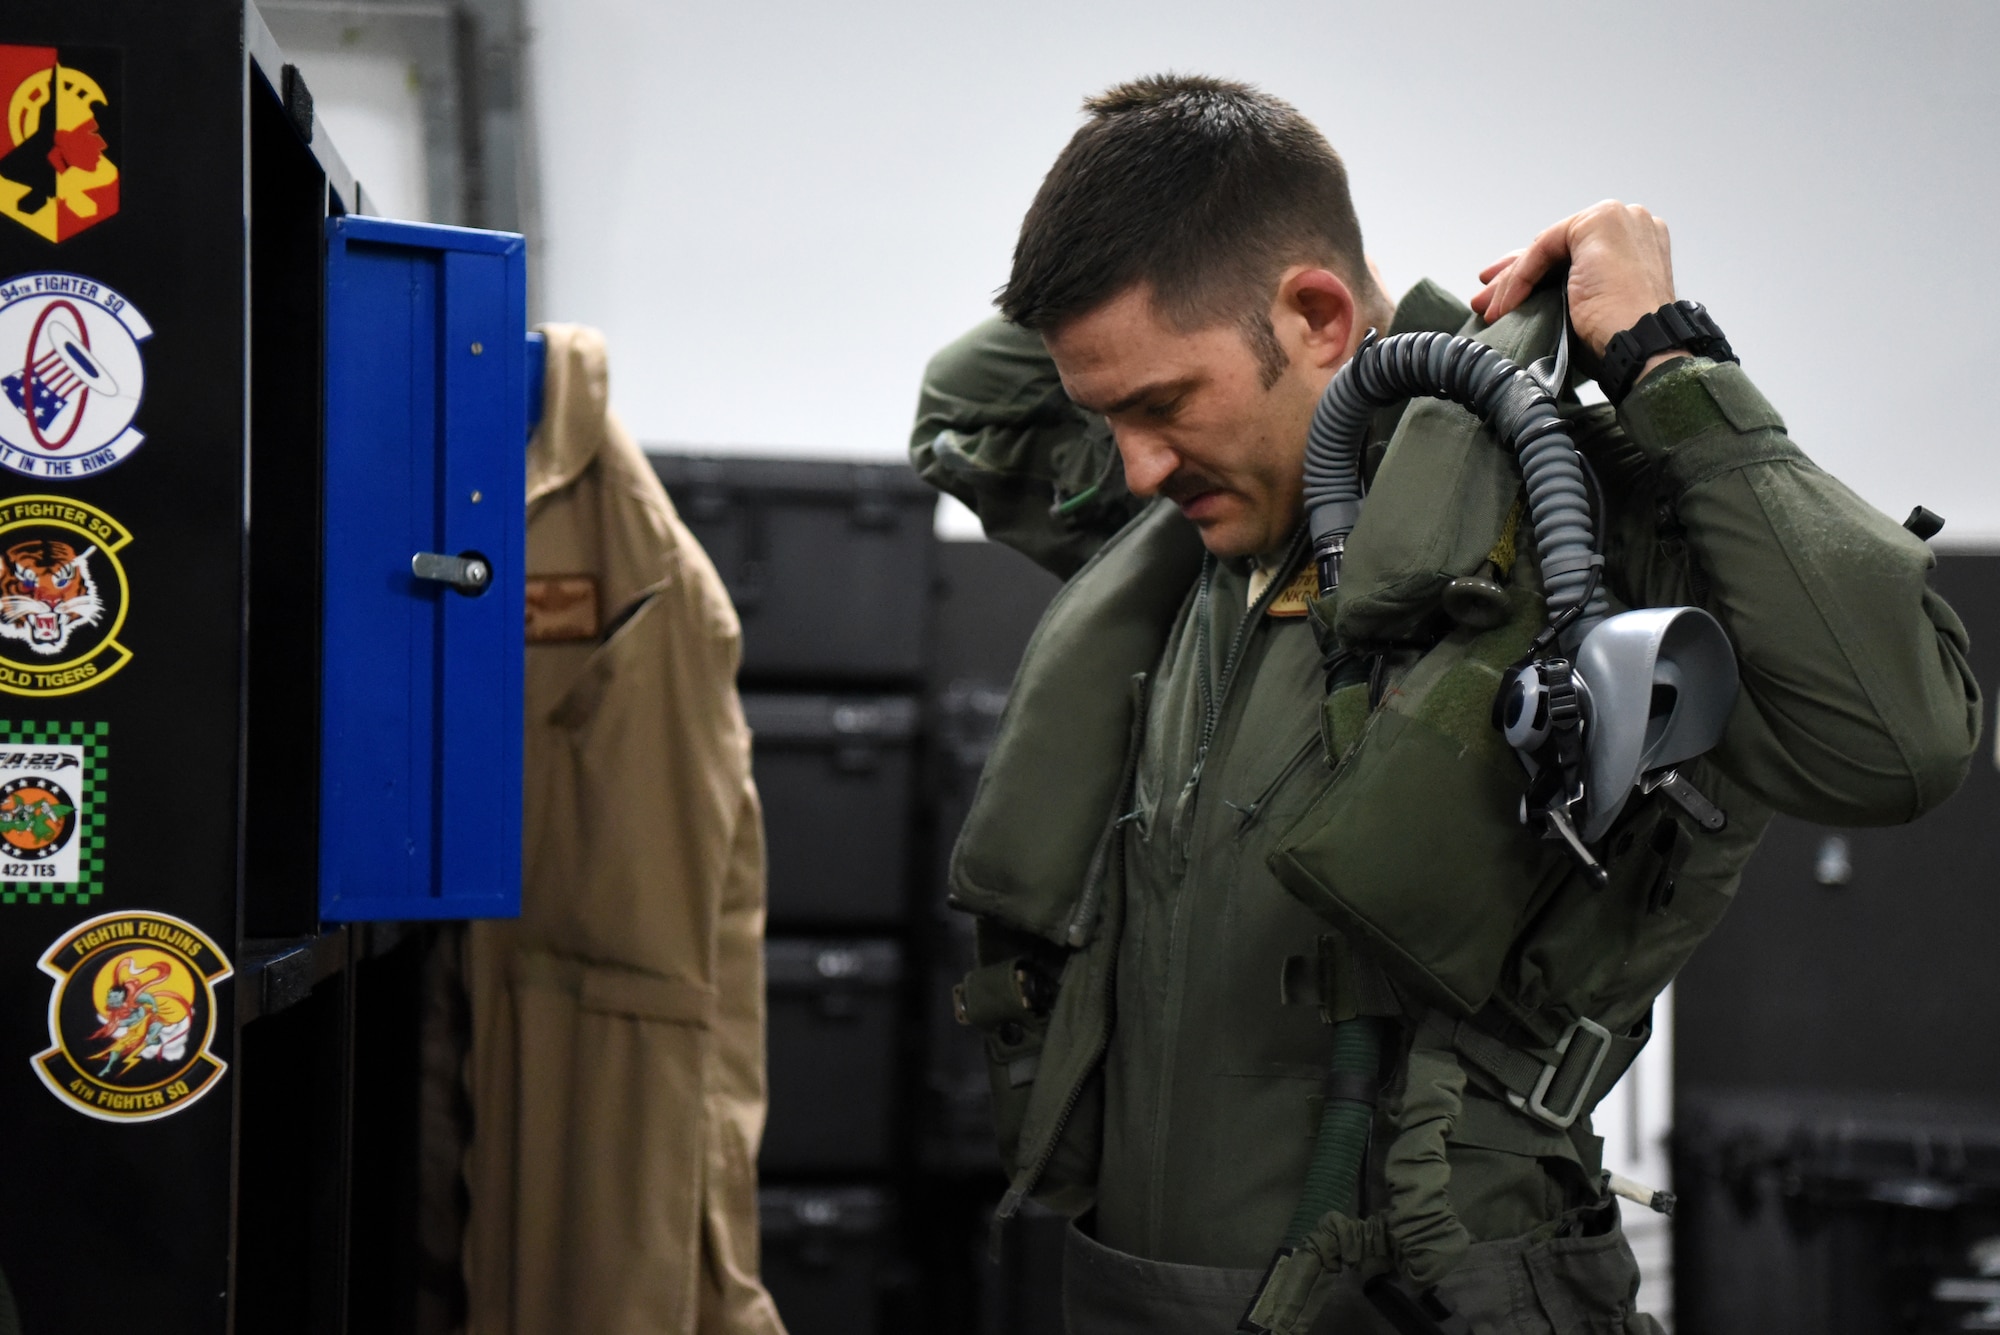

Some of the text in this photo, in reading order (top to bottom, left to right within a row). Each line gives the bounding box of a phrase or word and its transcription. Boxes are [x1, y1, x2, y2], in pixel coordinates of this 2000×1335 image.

[35, 276, 99, 299] FIGHTER
[104, 293, 126, 314] SQ
[19, 455, 35, 471] IN
[44, 460, 73, 476] THE
[82, 448, 117, 472] RING
[14, 503, 86, 526] FIGHTER
[88, 518, 113, 540] SQ
[34, 662, 98, 688] TIGERS
[2, 863, 57, 877] 422 TES
[73, 920, 203, 957] FIGHTIN FUUJINS
[97, 1089, 165, 1110] FIGHTER
[166, 1080, 190, 1100] SQ
